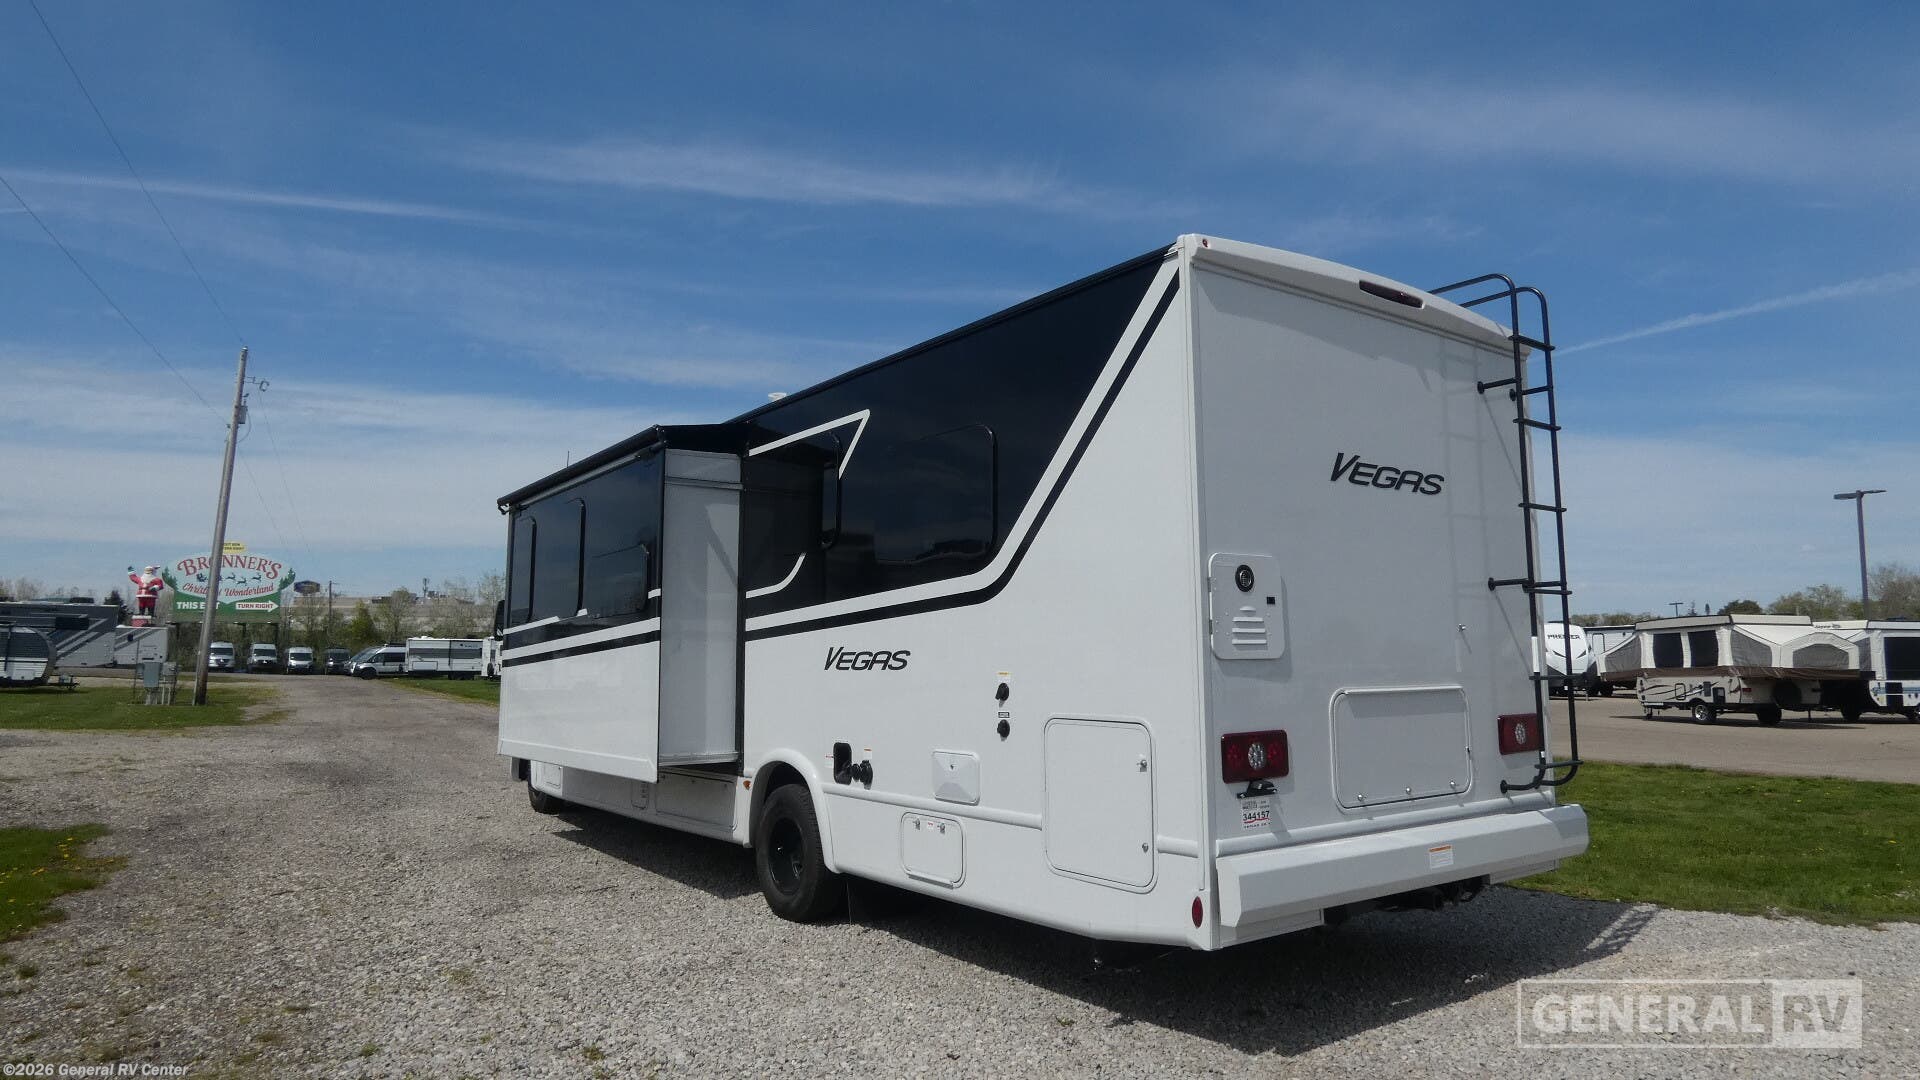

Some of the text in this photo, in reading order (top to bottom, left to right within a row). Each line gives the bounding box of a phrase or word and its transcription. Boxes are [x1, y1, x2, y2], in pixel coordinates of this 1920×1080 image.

[1330, 452, 1445, 495] VEGAS
[224, 582, 274, 597] Wonderland
[176, 601, 220, 610] THIS ET
[824, 646, 911, 671] VEGAS
[1242, 810, 1270, 821] 344157
